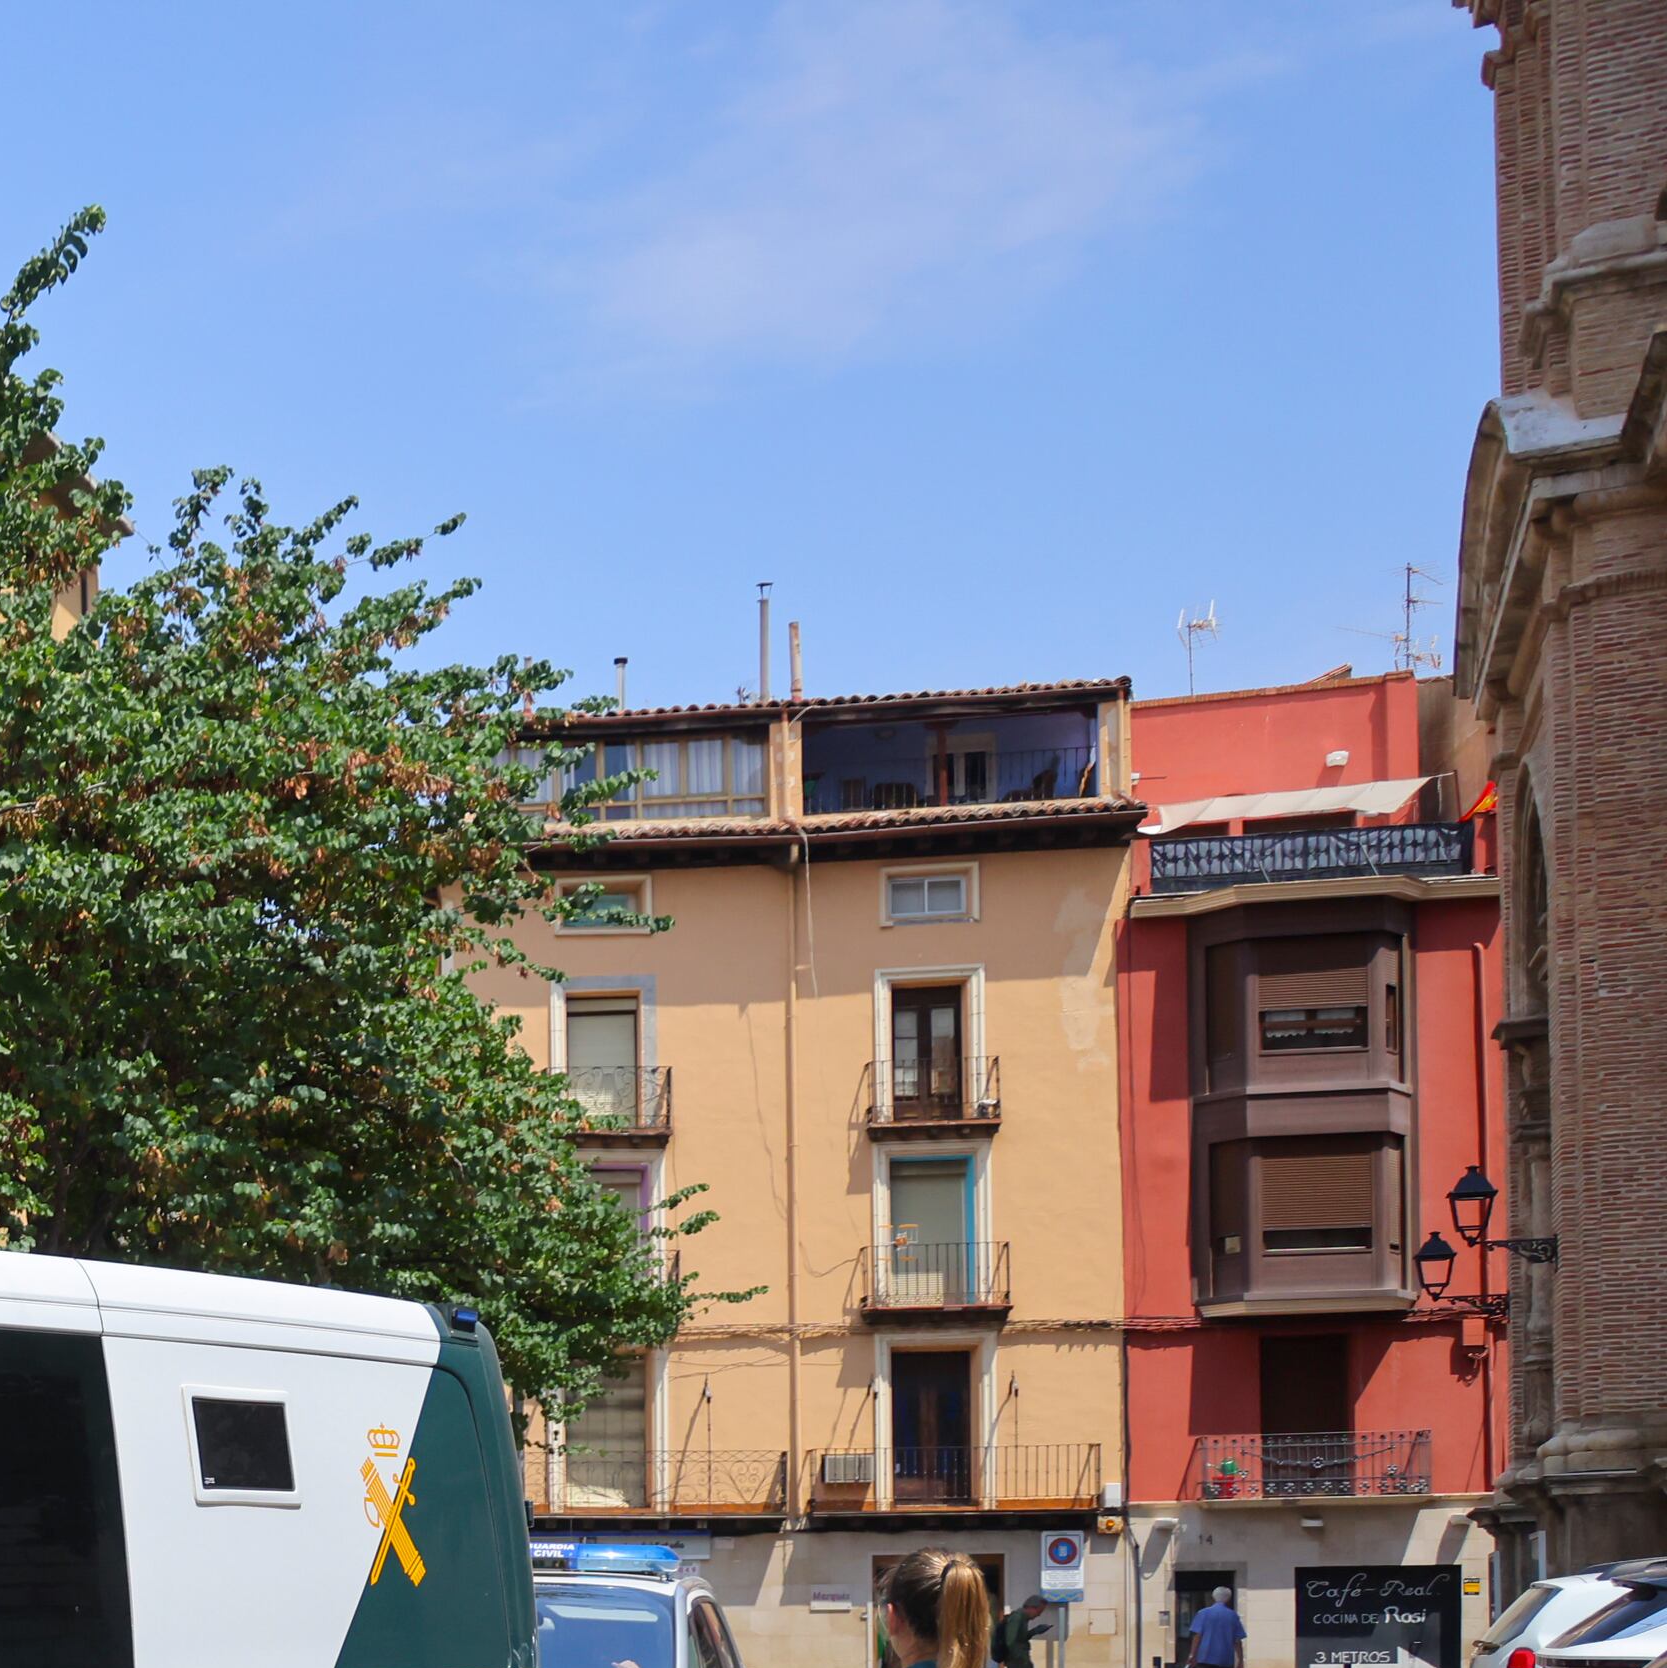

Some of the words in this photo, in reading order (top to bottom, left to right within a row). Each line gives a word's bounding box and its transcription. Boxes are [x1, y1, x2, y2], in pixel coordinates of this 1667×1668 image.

[1199, 1534, 1213, 1545] 14
[533, 1550, 565, 1558] CIVIL
[1313, 1612, 1359, 1625] COCINA
[1362, 1613, 1380, 1624] DE
[1384, 1606, 1427, 1624] Rosi
[1315, 1651, 1327, 1664] 3
[1331, 1651, 1391, 1666] METROS
